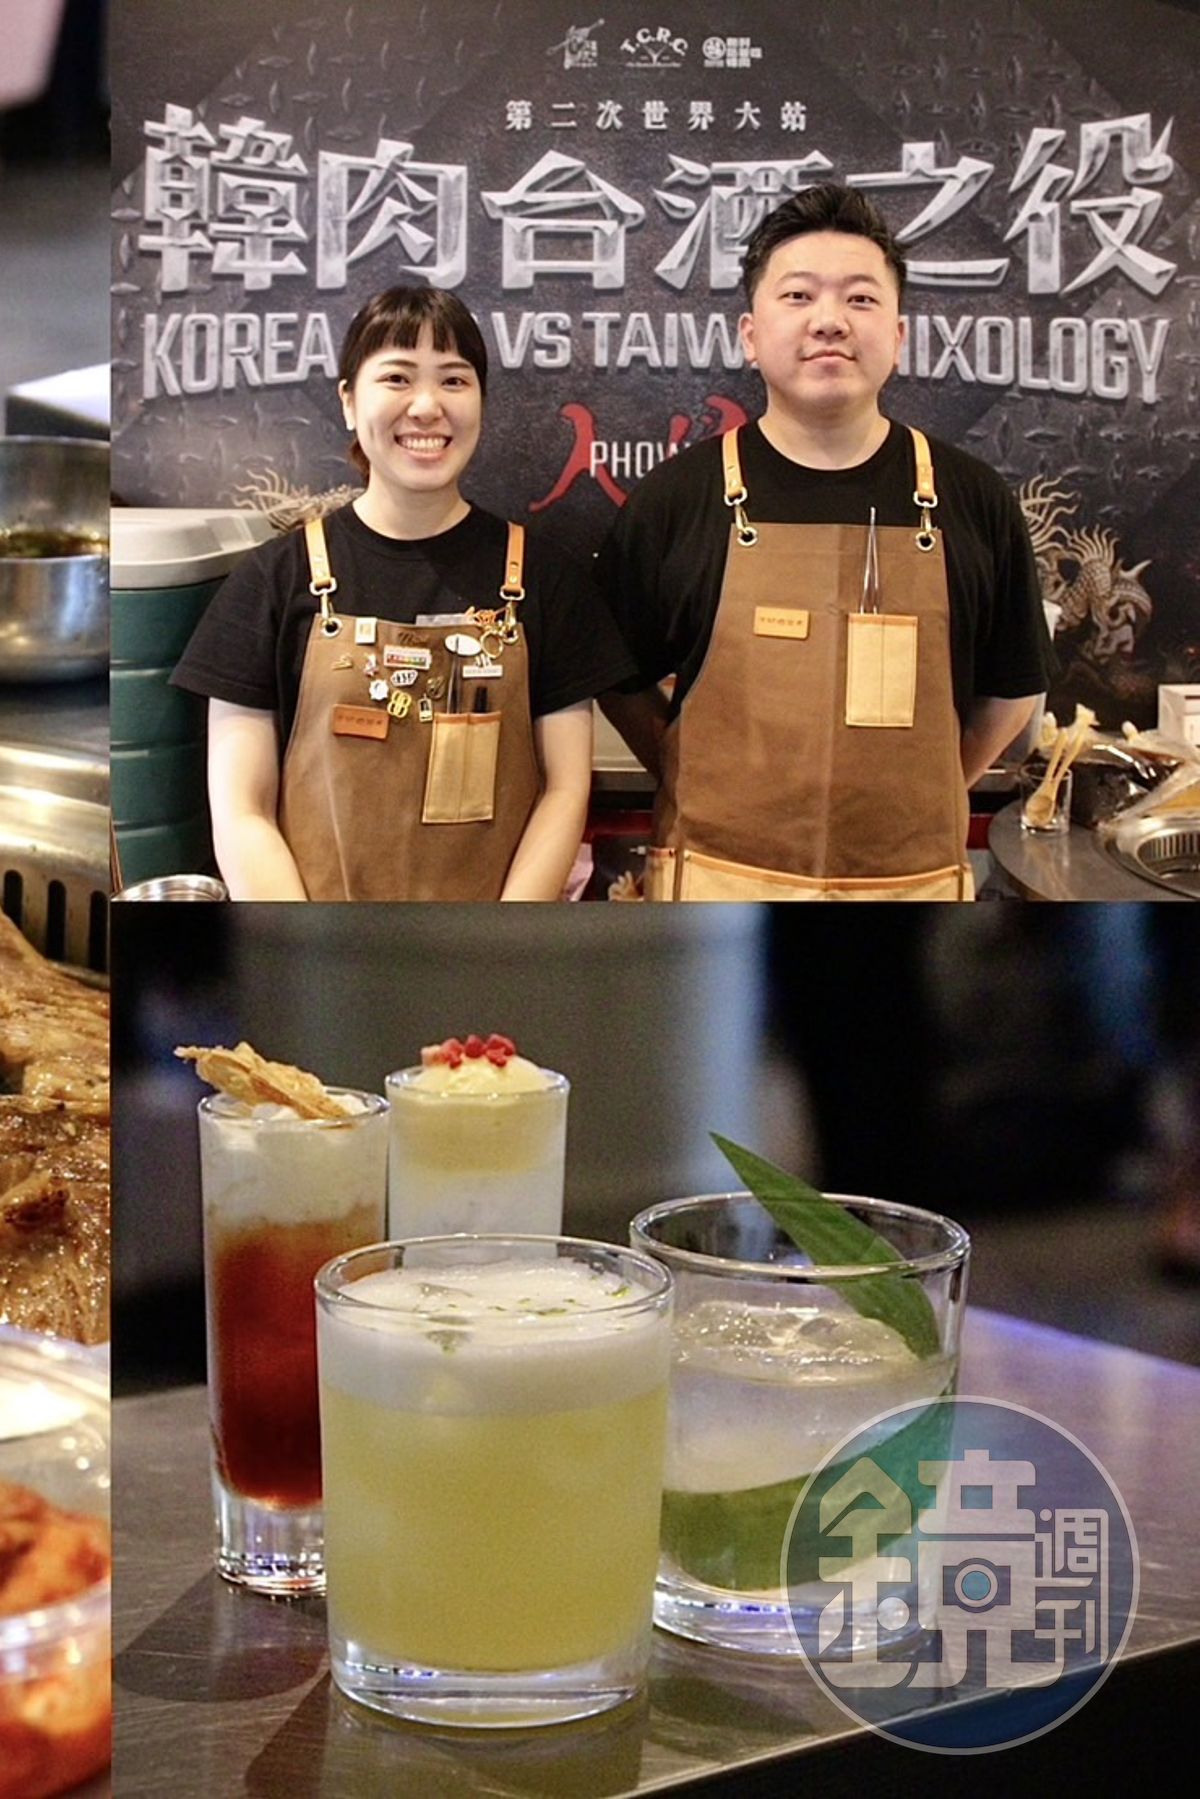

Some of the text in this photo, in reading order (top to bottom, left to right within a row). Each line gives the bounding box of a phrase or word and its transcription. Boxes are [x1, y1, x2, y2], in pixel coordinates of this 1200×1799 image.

[505, 100, 806, 131] 第二次世界大站
[143, 311, 1171, 404] KOREA VS TAIW IXOLOGY
